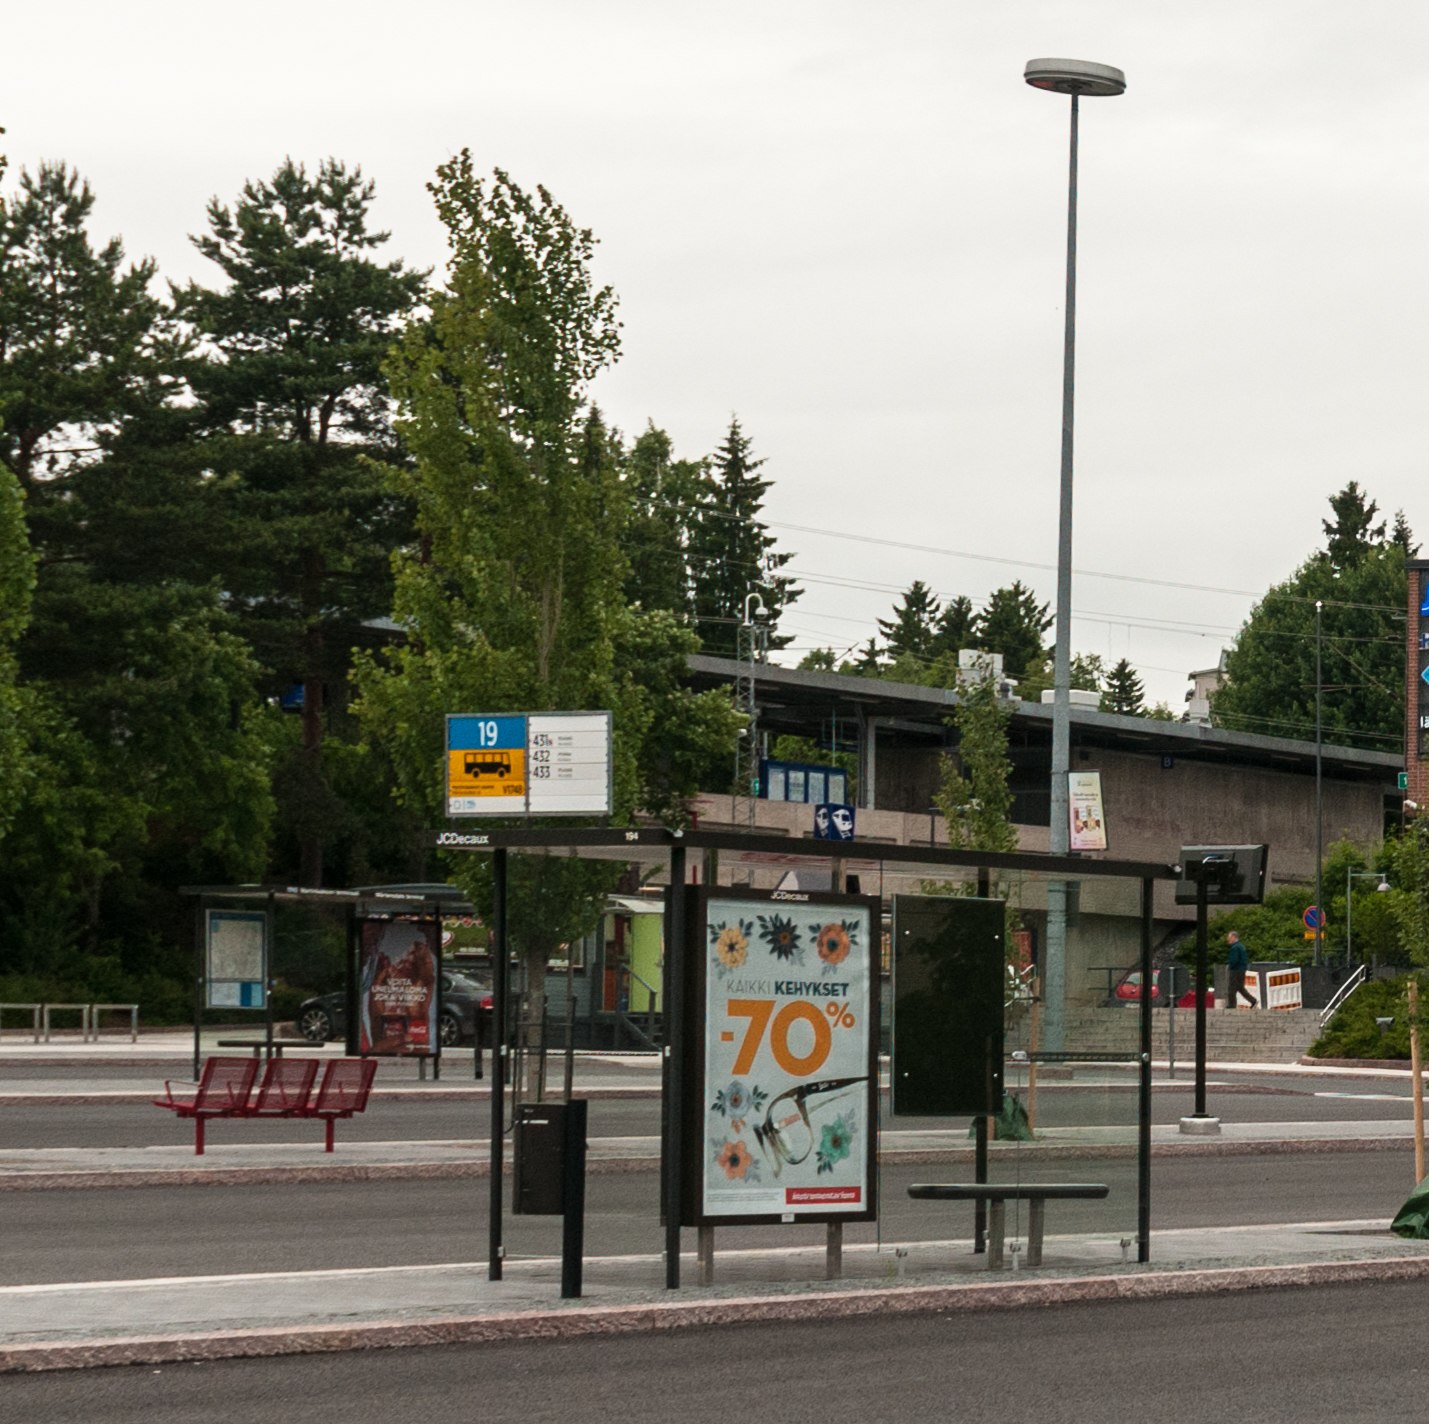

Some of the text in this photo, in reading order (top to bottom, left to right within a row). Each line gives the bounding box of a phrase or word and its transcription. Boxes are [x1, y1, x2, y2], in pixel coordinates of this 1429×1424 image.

[477, 721, 498, 746] 19
[533, 750, 551, 763] 432
[533, 766, 551, 779] 433
[437, 832, 489, 845] JCDecaux
[726, 979, 849, 997] KAIKKI KEHYKSET
